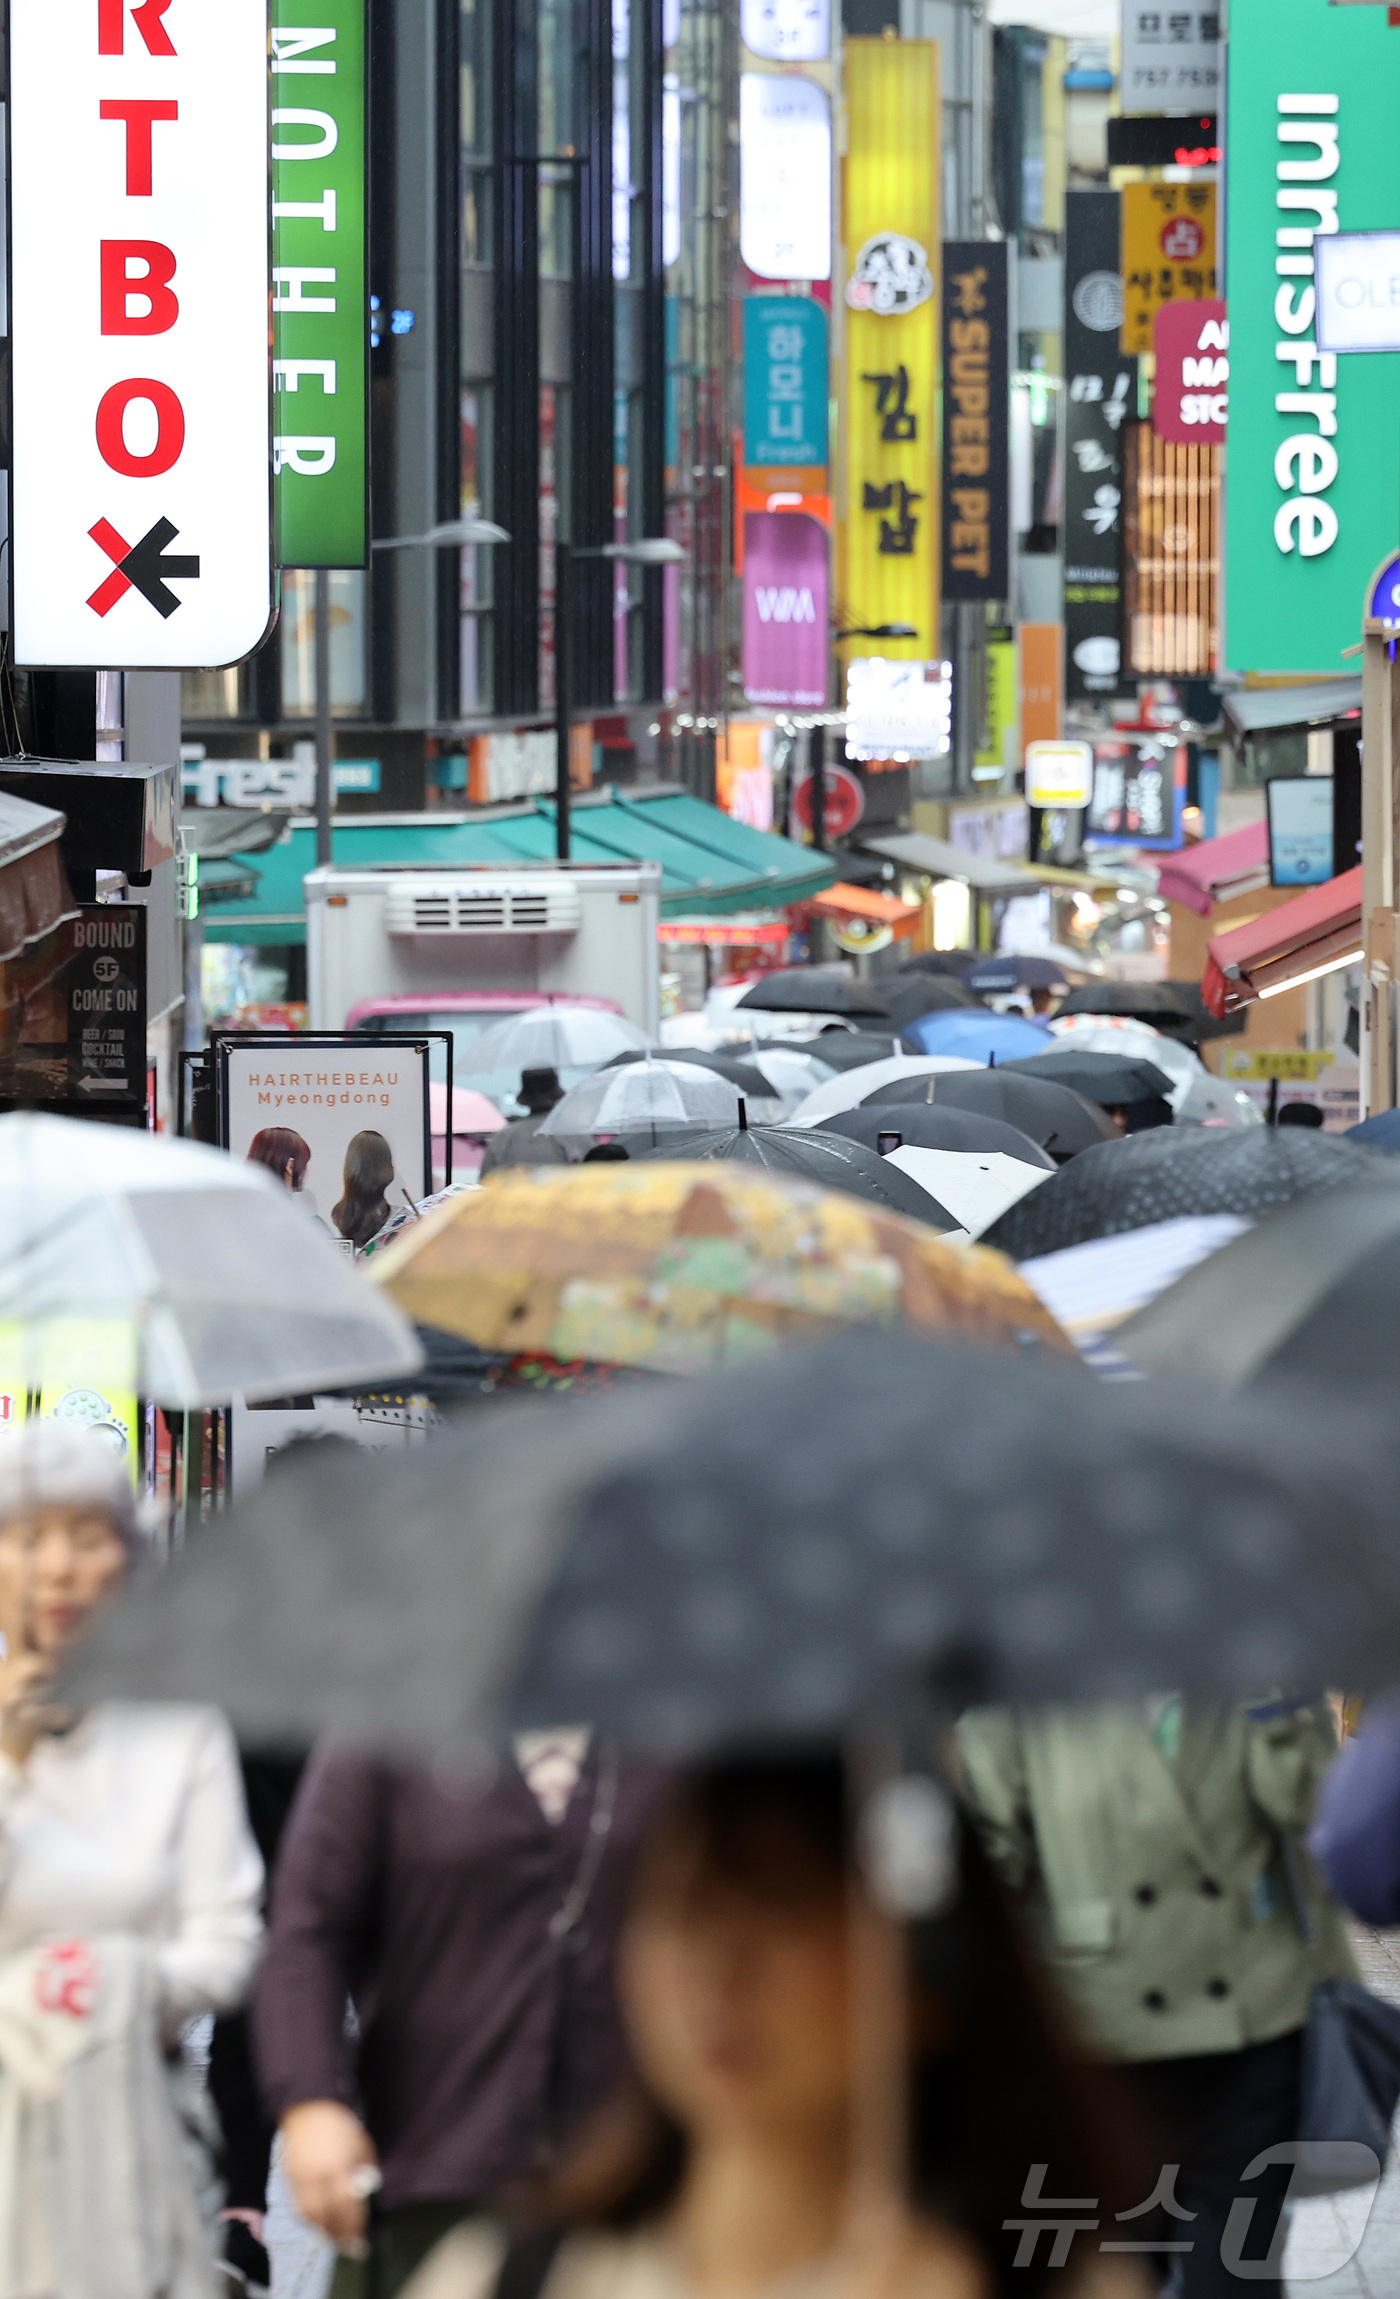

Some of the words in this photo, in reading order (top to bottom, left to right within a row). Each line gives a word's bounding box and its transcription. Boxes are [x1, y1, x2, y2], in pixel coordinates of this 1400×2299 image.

[950, 320, 990, 477] SUPER
[950, 488, 990, 578] PET
[74, 922, 135, 948] BOUND
[95, 963, 118, 976] 5F
[72, 989, 113, 1012] COME
[116, 989, 138, 1012] ON
[81, 1042, 124, 1057] COCKTAIL
[249, 1073, 398, 1086] HAIRTHEBEAU
[258, 1091, 390, 1107] Myeongdong
